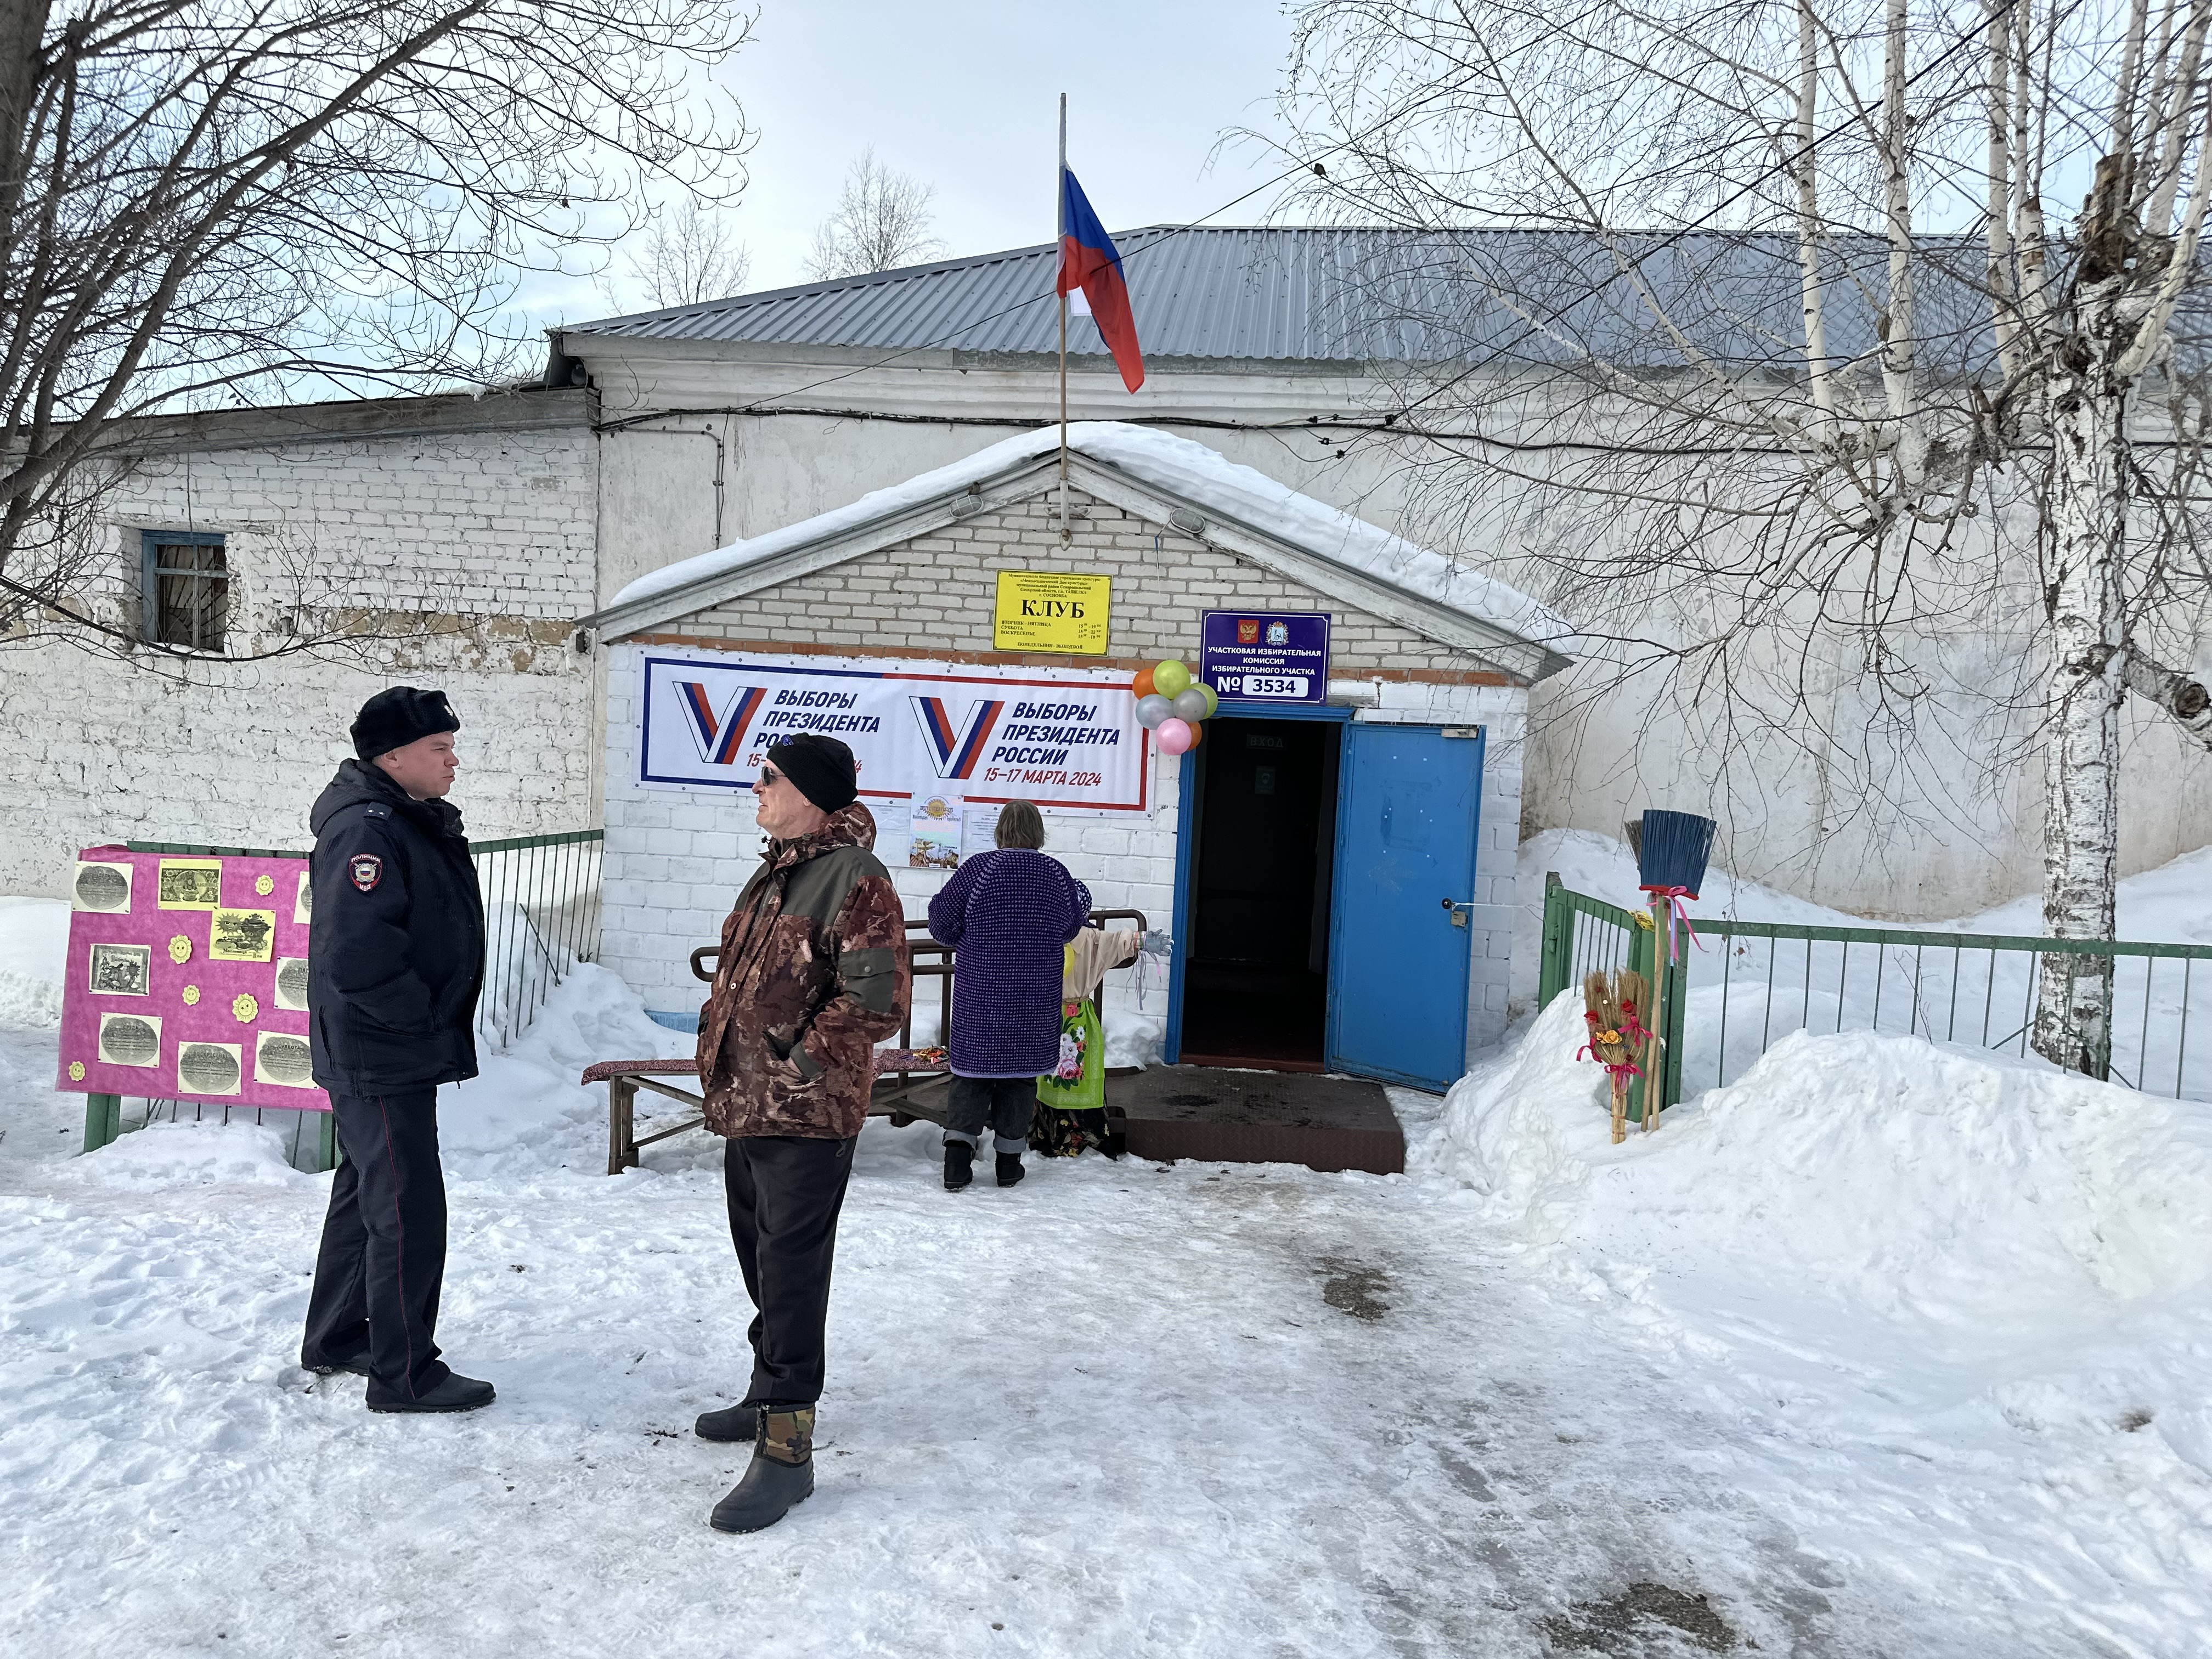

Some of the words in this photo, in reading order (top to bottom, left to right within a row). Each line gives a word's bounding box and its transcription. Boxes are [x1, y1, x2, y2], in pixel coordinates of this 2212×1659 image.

[1020, 600, 1084, 618] КЛУБ
[1207, 646, 1256, 654] УЧАСТКОВАЯ
[1257, 648, 1321, 657] ИЗБИРАТЕЛЬНАЯ
[1212, 665, 1280, 674] ИЗБИРАТЕЛЬНОГО
[1217, 676, 1241, 692] №
[1252, 679, 1296, 693] 3534
[774, 689, 858, 709] ВЫБОРЫ
[1012, 702, 1097, 722] ВЫБОРЫ
[763, 711, 881, 733] ПРЕЗИДЕНТА
[1002, 724, 1120, 746] ПРЕЗИДЕНТА
[1250, 737, 1283, 748] ВХОД
[991, 746, 1069, 765] РОССИИ
[1022, 770, 1067, 786] МАРТА
[1068, 772, 1102, 787] 2024
[351, 855, 380, 863] ПОЛИЦИЯ
